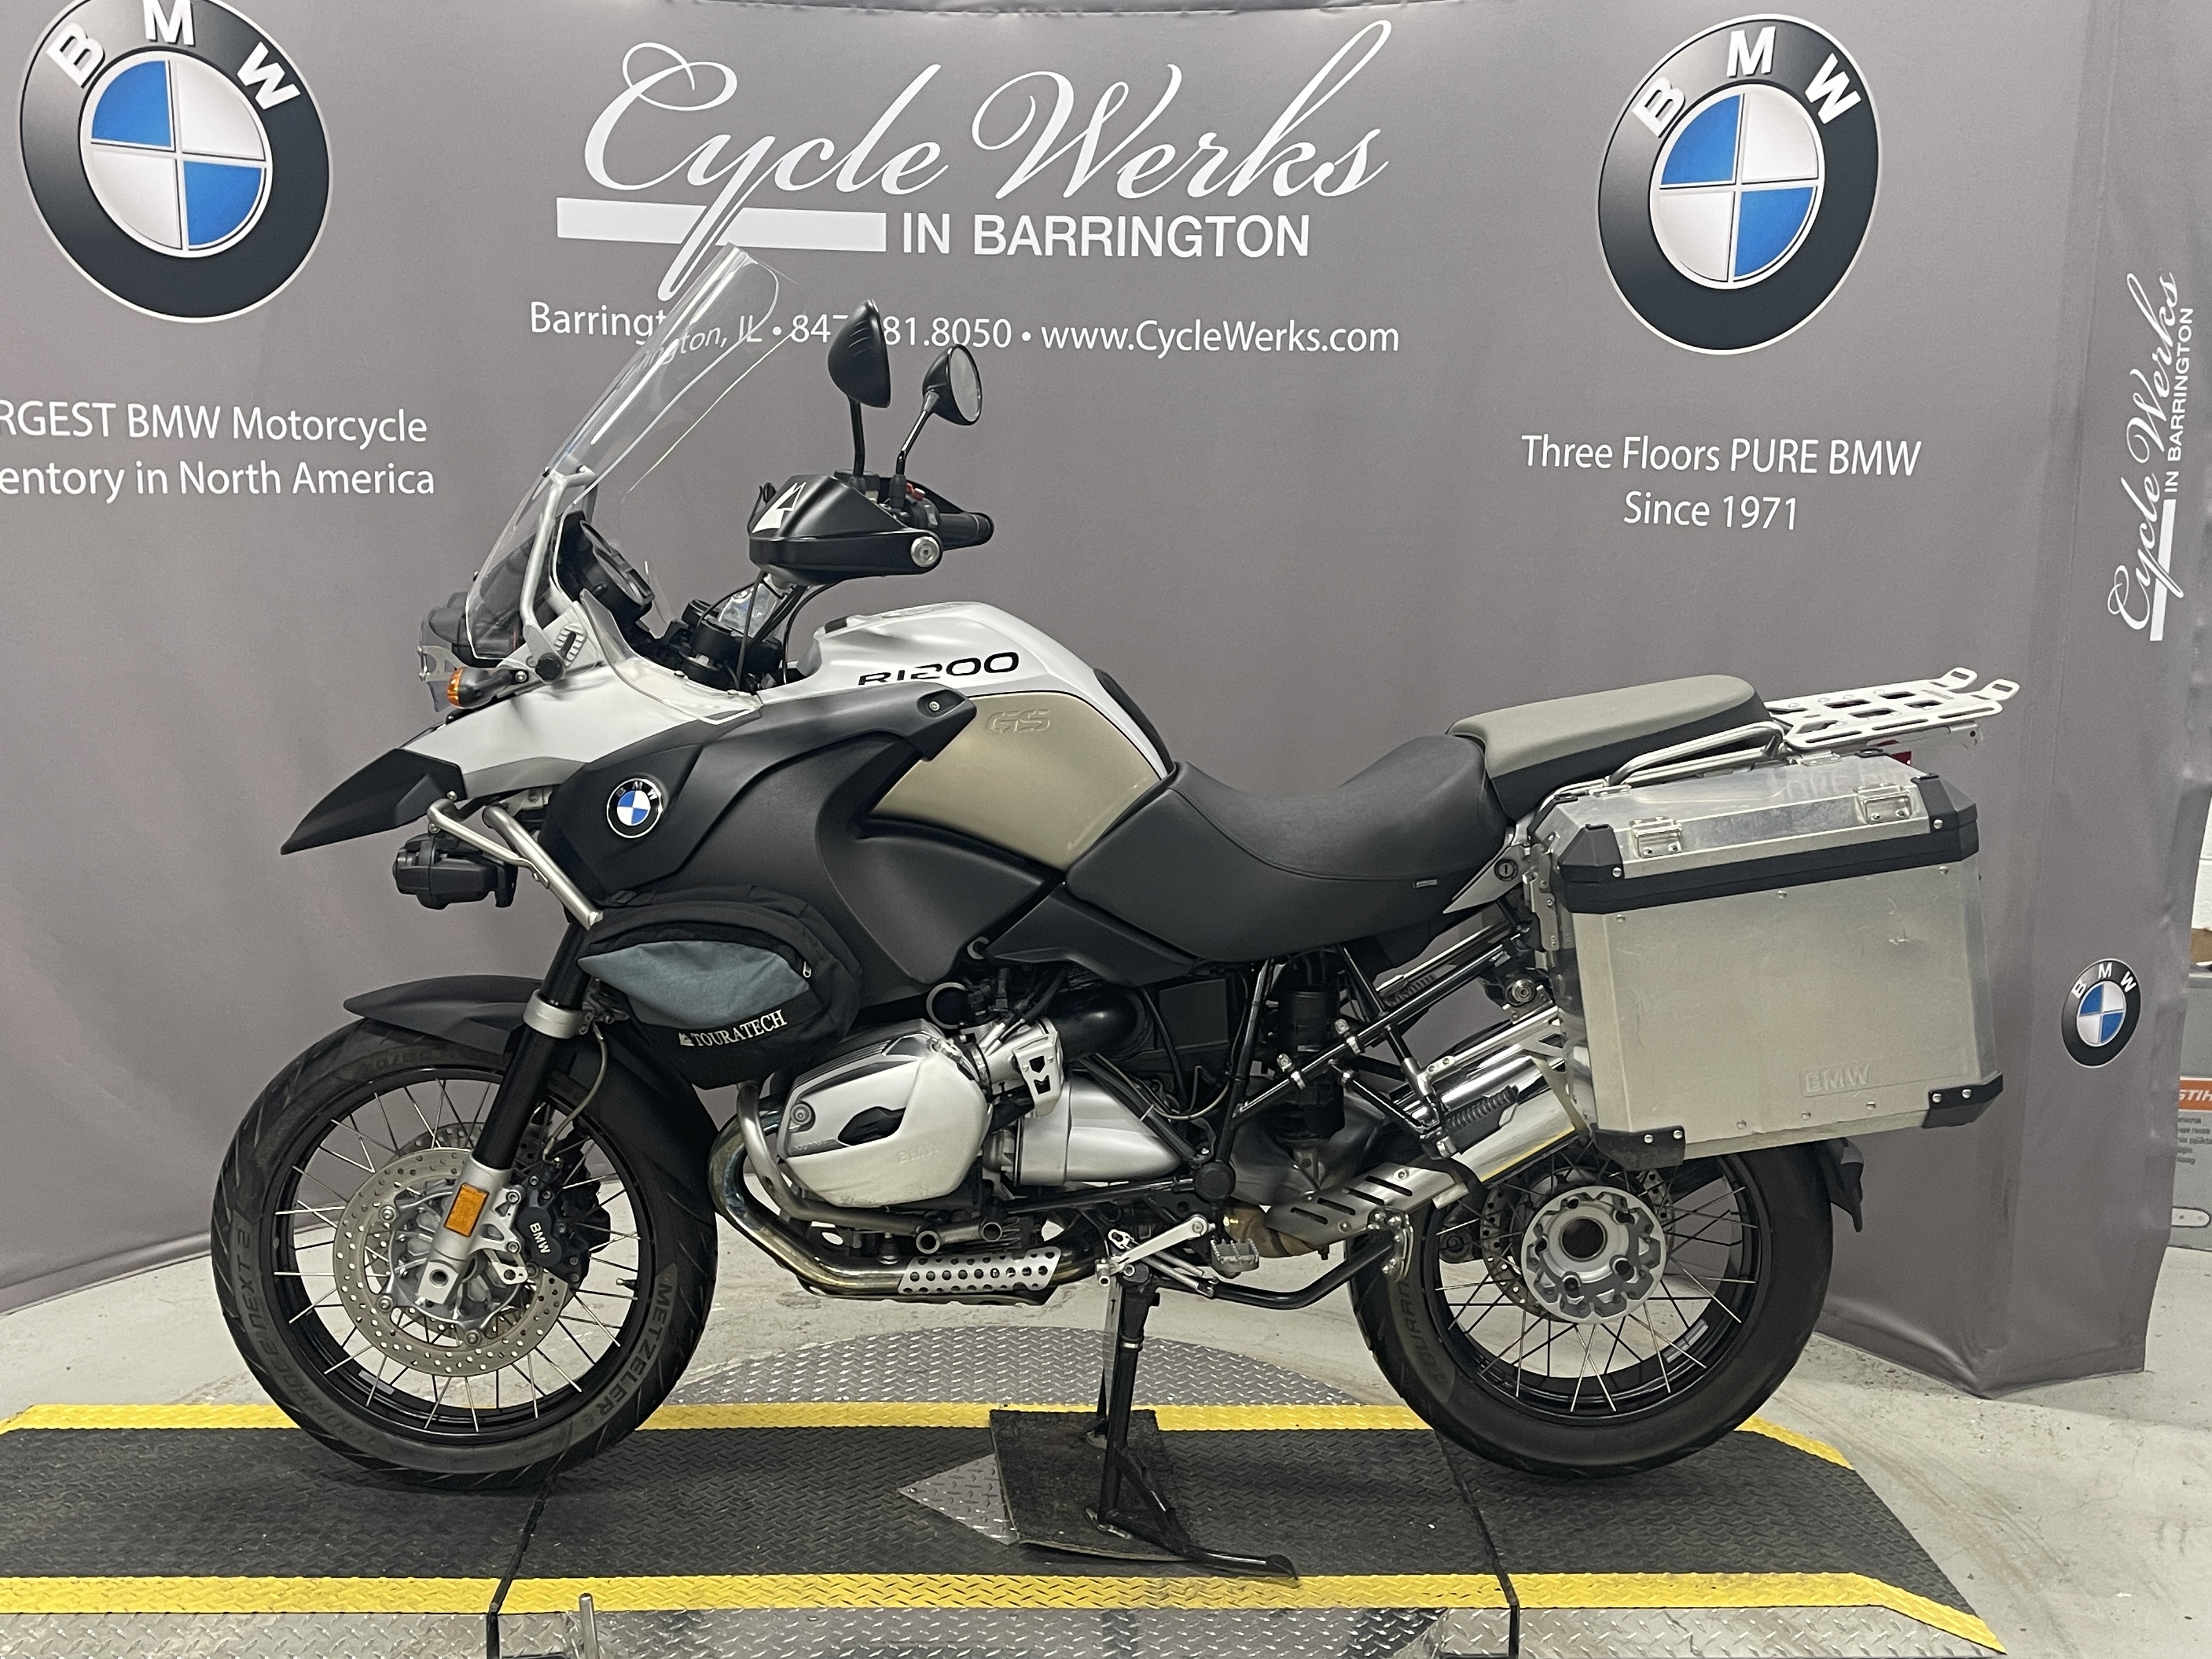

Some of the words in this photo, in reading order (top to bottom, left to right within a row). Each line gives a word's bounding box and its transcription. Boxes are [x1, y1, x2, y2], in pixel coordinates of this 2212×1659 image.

[46, 0, 301, 110] BMW
[1632, 26, 1861, 137] BMW
[584, 42, 949, 301] Cycle
[972, 20, 1391, 200] Werks
[904, 213, 949, 253] IN
[975, 215, 1309, 257] BARRINGTON
[738, 315, 763, 342] IL
[791, 314, 1012, 348] 8481.8050
[1041, 319, 1398, 359] www.CycleWerks.com
[2126, 272, 2178, 464] Werks
[2168, 308, 2193, 461] BARRINGTON
[128, 404, 220, 438] BMW
[234, 407, 426, 449] Motorcycle
[1522, 434, 1612, 468] Three
[1623, 436, 1719, 471] Floors
[1731, 438, 1818, 473] PURE
[1830, 440, 1921, 476] BMW
[0, 462, 125, 504] entory
[137, 461, 167, 493] in
[180, 460, 280, 494] North
[292, 462, 433, 493] America
[2165, 471, 2179, 492] IN
[1624, 491, 1709, 526] Since
[1724, 496, 1795, 529] 1971
[2107, 472, 2183, 629] Cycle
[858, 652, 1019, 686] R1200
[985, 709, 1051, 734] GS
[615, 781, 659, 800] BMW
[2071, 962, 2136, 999] BMW
[690, 1009, 787, 1046] TOURATECH
[1805, 1064, 1870, 1092] BMW
[529, 1222, 551, 1253] BMW
[237, 1254, 268, 1330] NEXT
[596, 1282, 673, 1416] METZELER
